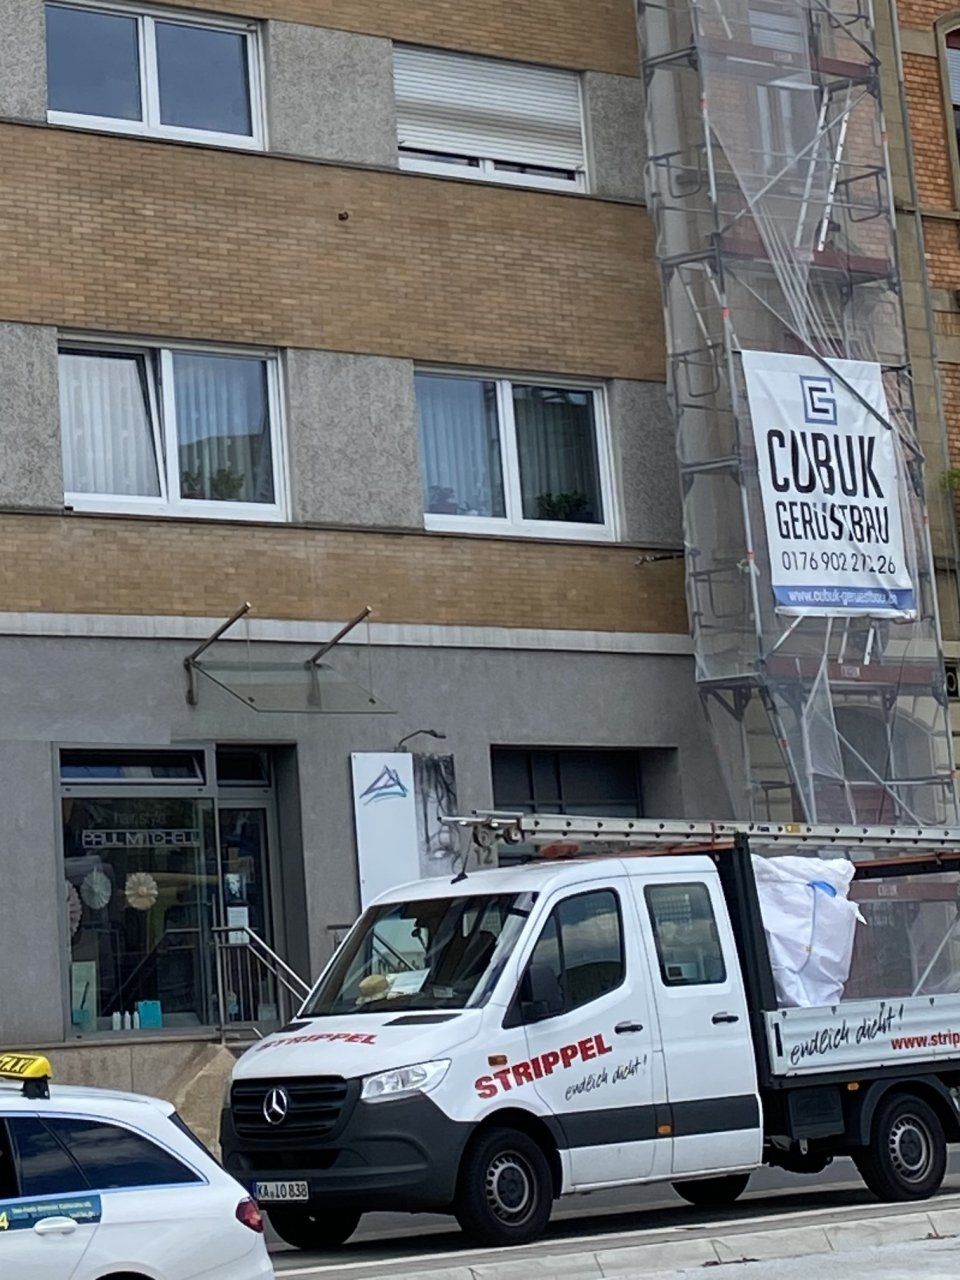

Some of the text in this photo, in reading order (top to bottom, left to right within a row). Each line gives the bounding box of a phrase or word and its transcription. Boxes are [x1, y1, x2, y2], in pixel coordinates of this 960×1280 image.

[767, 429, 884, 499] CUBUK
[782, 550, 818, 571] 0176
[821, 551, 848, 571] 902
[82, 830, 124, 847] PAUL
[255, 1033, 378, 1052] STRIPPEL
[474, 1033, 613, 1099] STRIPPEL
[565, 1067, 608, 1101] endlich
[288, 1183, 308, 1198] 838
